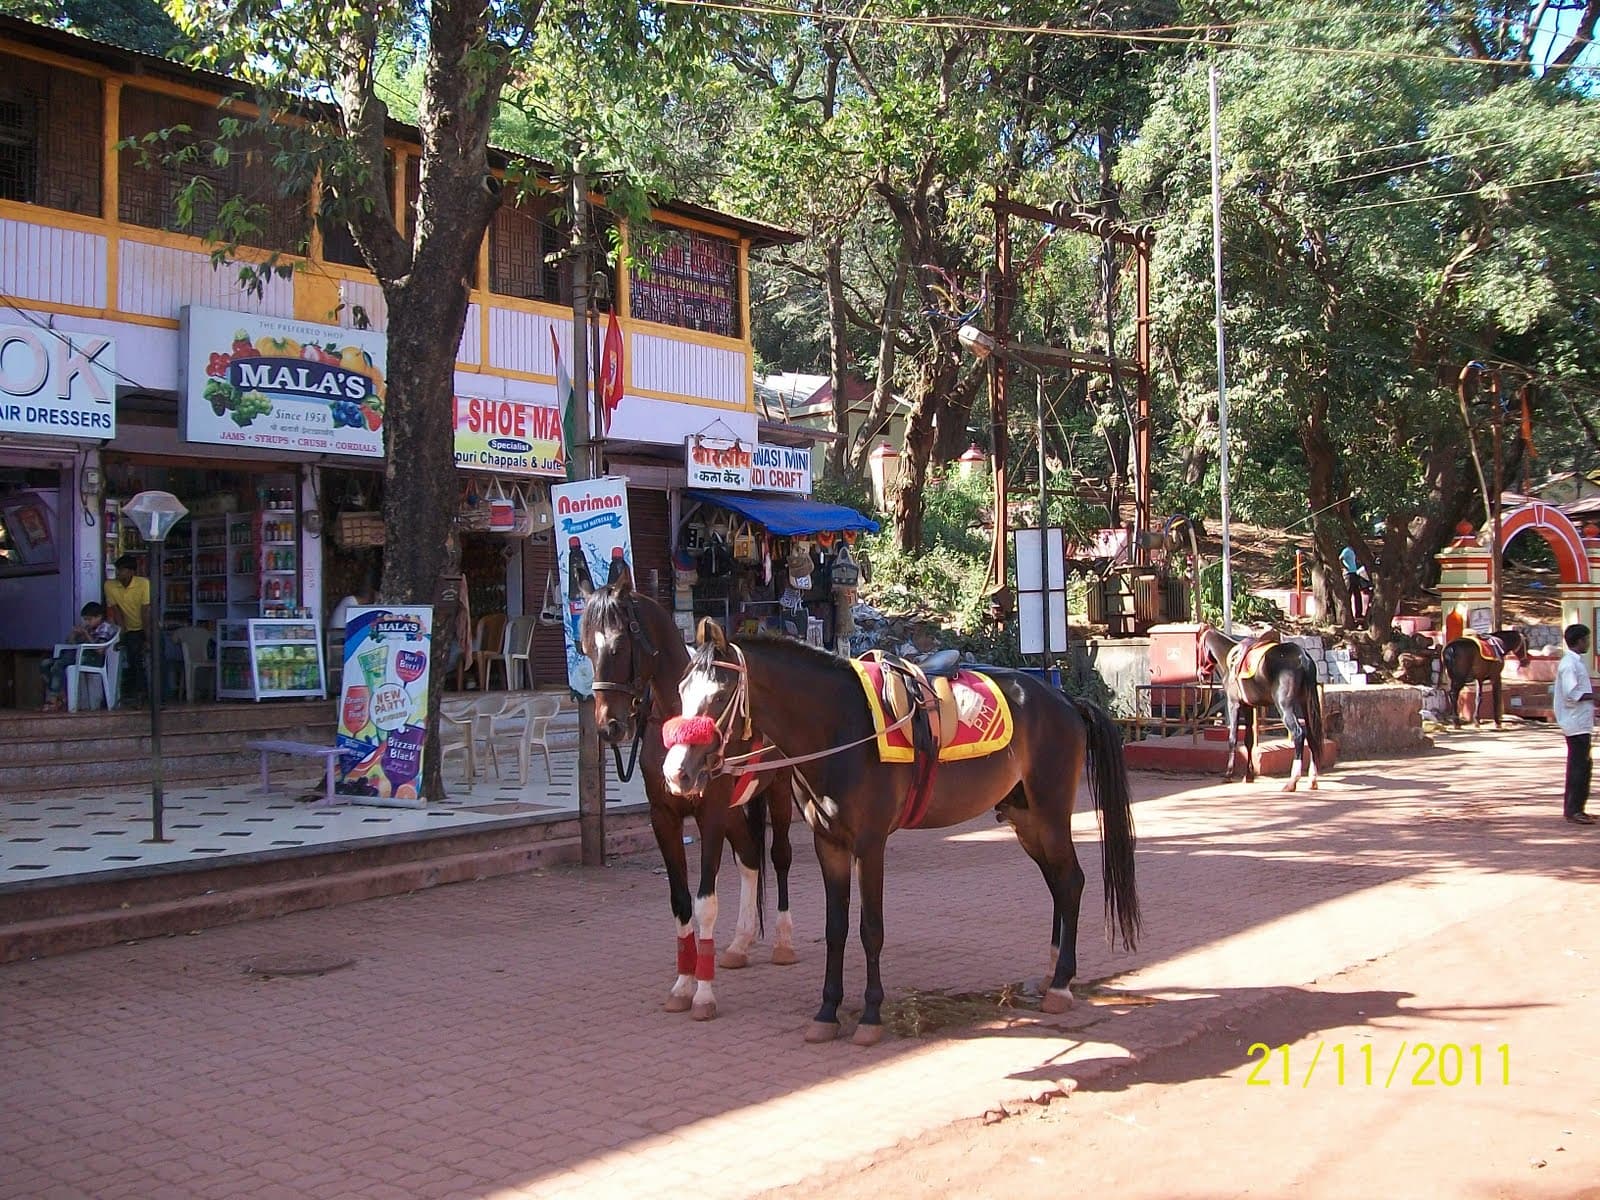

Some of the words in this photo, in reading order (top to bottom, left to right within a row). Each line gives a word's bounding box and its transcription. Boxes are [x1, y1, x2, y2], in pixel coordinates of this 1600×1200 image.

[239, 363, 366, 399] MALA'S
[26, 407, 111, 429] DRESSERS
[275, 409, 301, 421] Since
[305, 411, 327, 423] 1958
[468, 398, 526, 437] SHOE
[220, 431, 245, 441] JAMS
[254, 434, 289, 444] SYRUPS
[297, 438, 327, 448] CRUSH
[335, 441, 377, 452] CORDIALS
[491, 440, 529, 452] Specialist
[480, 451, 527, 469] Chappals
[531, 456, 538, 468] &
[784, 450, 808, 471] MINI
[769, 469, 803, 488] CRAFT
[558, 493, 622, 514] Nariman
[377, 623, 418, 631] MALA'S
[376, 689, 401, 704] NEW
[374, 698, 406, 715] PARTY
[391, 748, 416, 761] Black
